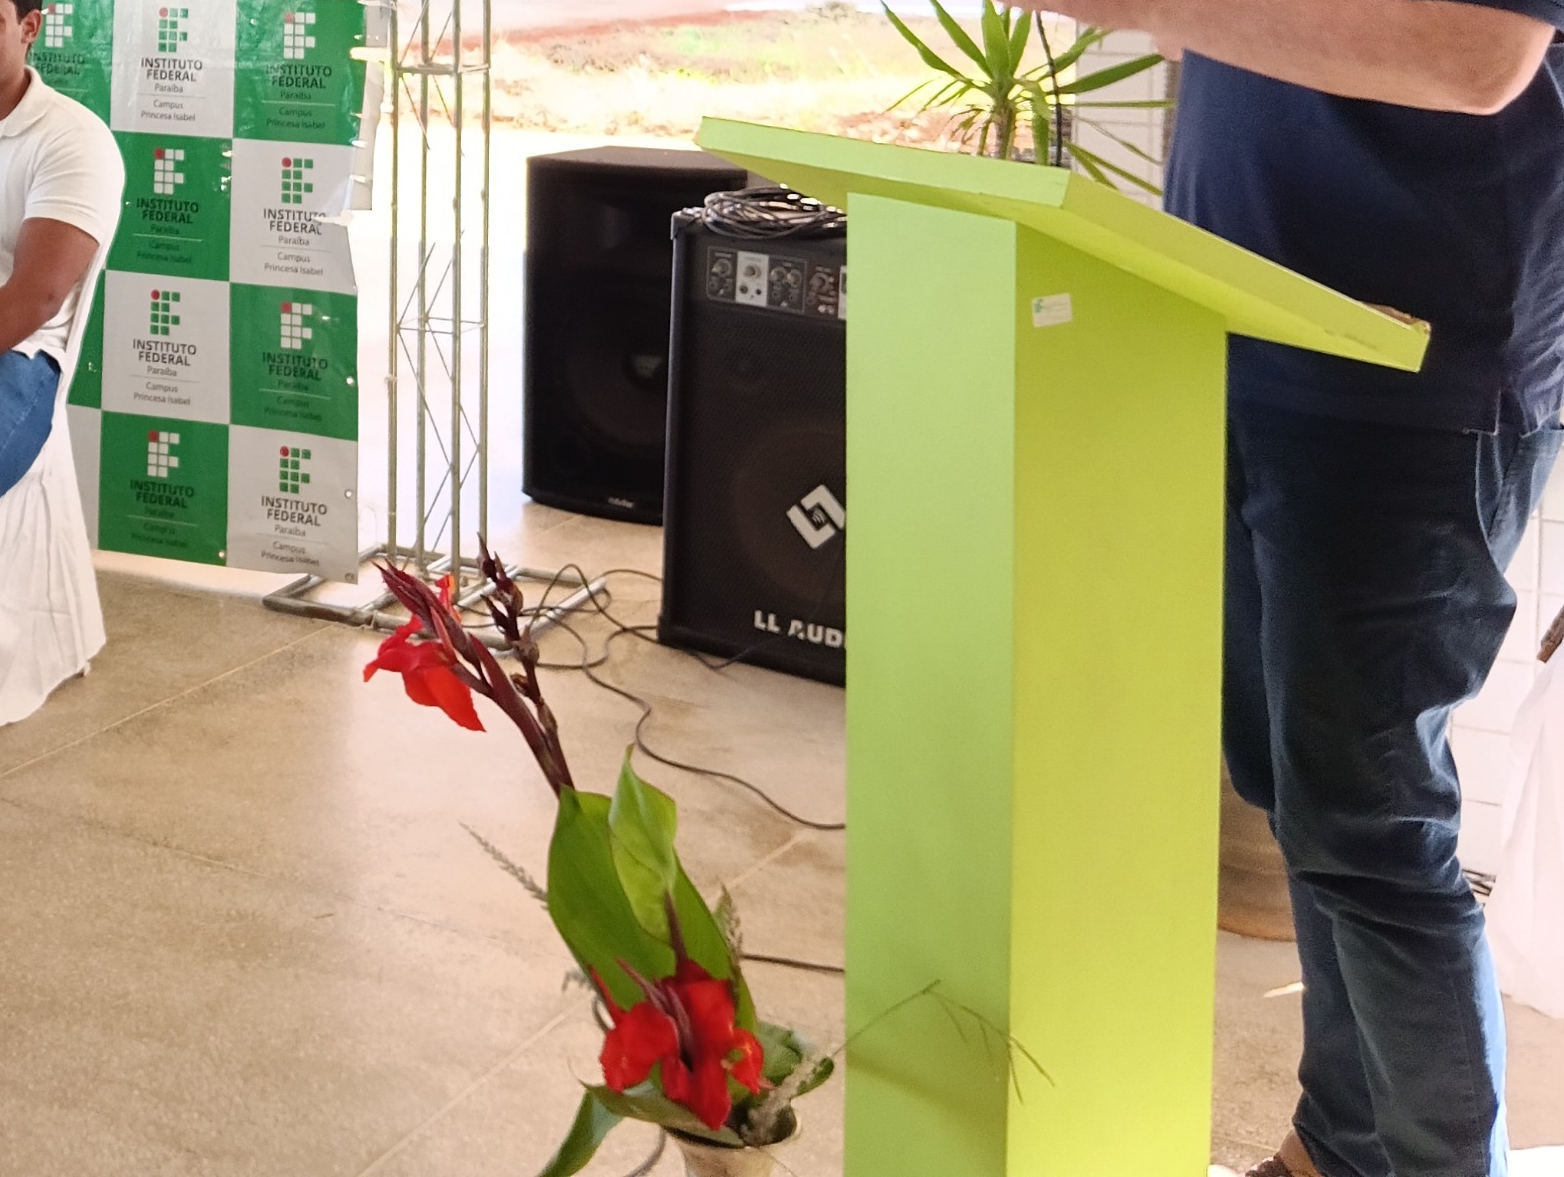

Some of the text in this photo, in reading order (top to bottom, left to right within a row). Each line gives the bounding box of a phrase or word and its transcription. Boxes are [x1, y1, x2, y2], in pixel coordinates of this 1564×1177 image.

[141, 58, 203, 69] INSTITUTO
[266, 63, 332, 76] INSTITUTO
[146, 69, 196, 81] FEDERAL
[272, 75, 325, 88] FEDERAL
[154, 83, 183, 92] Paraíba
[153, 99, 183, 111] Campus
[141, 111, 196, 120] Princesa Isabel
[279, 107, 311, 119] Campus
[137, 198, 199, 212] INSTITUTO
[142, 210, 193, 223] FEDERAL
[277, 235, 308, 246] Paraíba
[277, 252, 308, 265] Campus
[265, 263, 322, 275] Princesa Isabel
[132, 338, 197, 355] INSTITUTO
[138, 350, 191, 366] FEDERAL
[262, 352, 329, 369] INSTITUTO
[147, 365, 177, 376] Paraíba
[269, 364, 322, 380] FEDERAL
[146, 382, 177, 395] Campus
[134, 392, 190, 405] Princesa Isabel
[130, 479, 195, 496] INSTITUTO
[136, 491, 188, 507] FEDERAL
[261, 496, 327, 514] INSTITUTO
[267, 508, 320, 525] FEDERAL
[275, 524, 306, 535] Paraíba
[273, 540, 306, 555] Campus
[261, 551, 294, 563] Princesa
[754, 610, 845, 649] LL AUD
